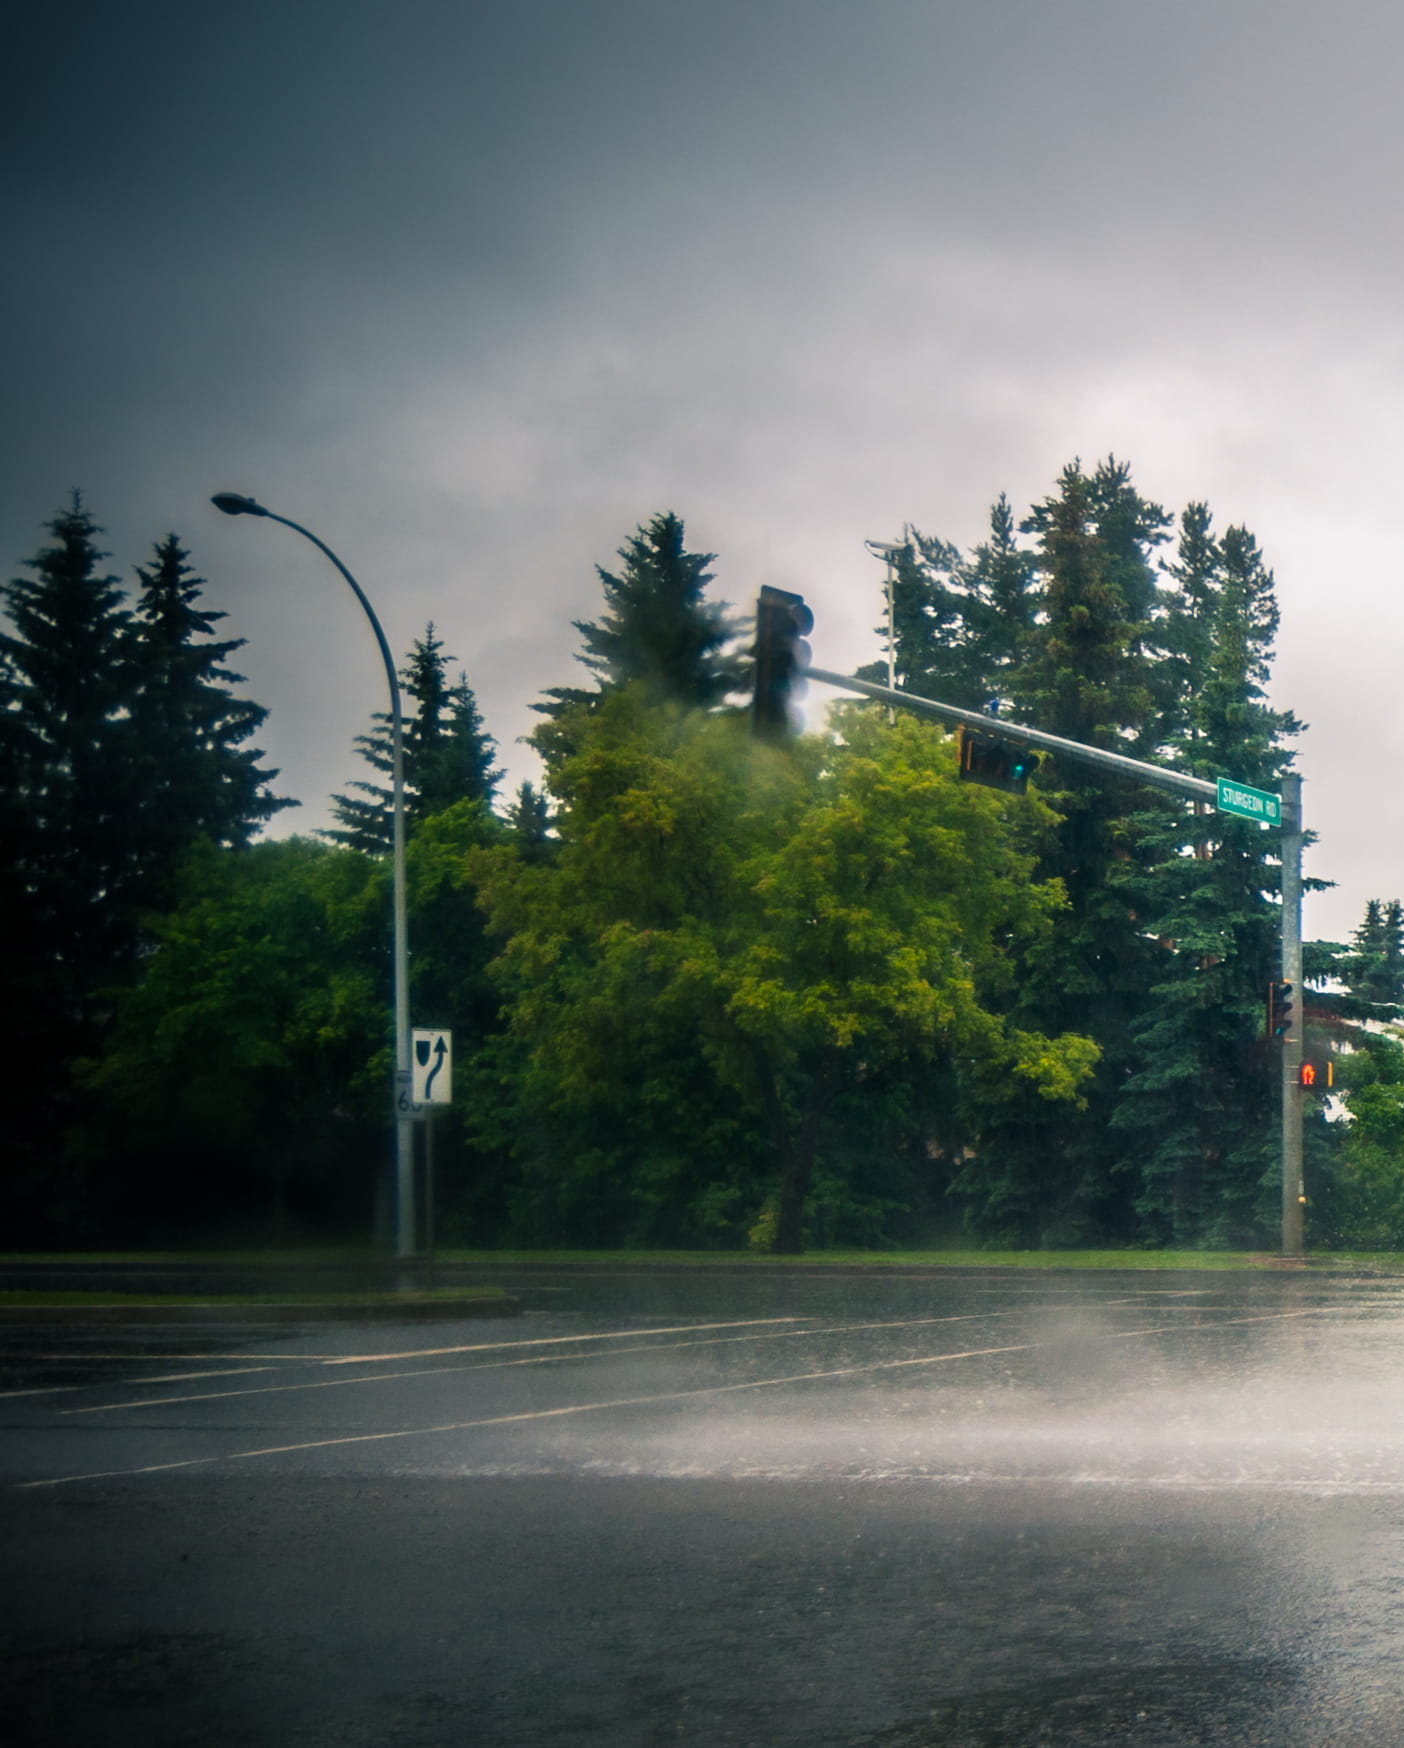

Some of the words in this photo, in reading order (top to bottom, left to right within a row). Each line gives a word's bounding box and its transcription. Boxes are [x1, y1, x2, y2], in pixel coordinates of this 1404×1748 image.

[1223, 787, 1263, 813] STURGEON
[1265, 800, 1277, 817] RD
[398, 1090, 423, 1112] 6
